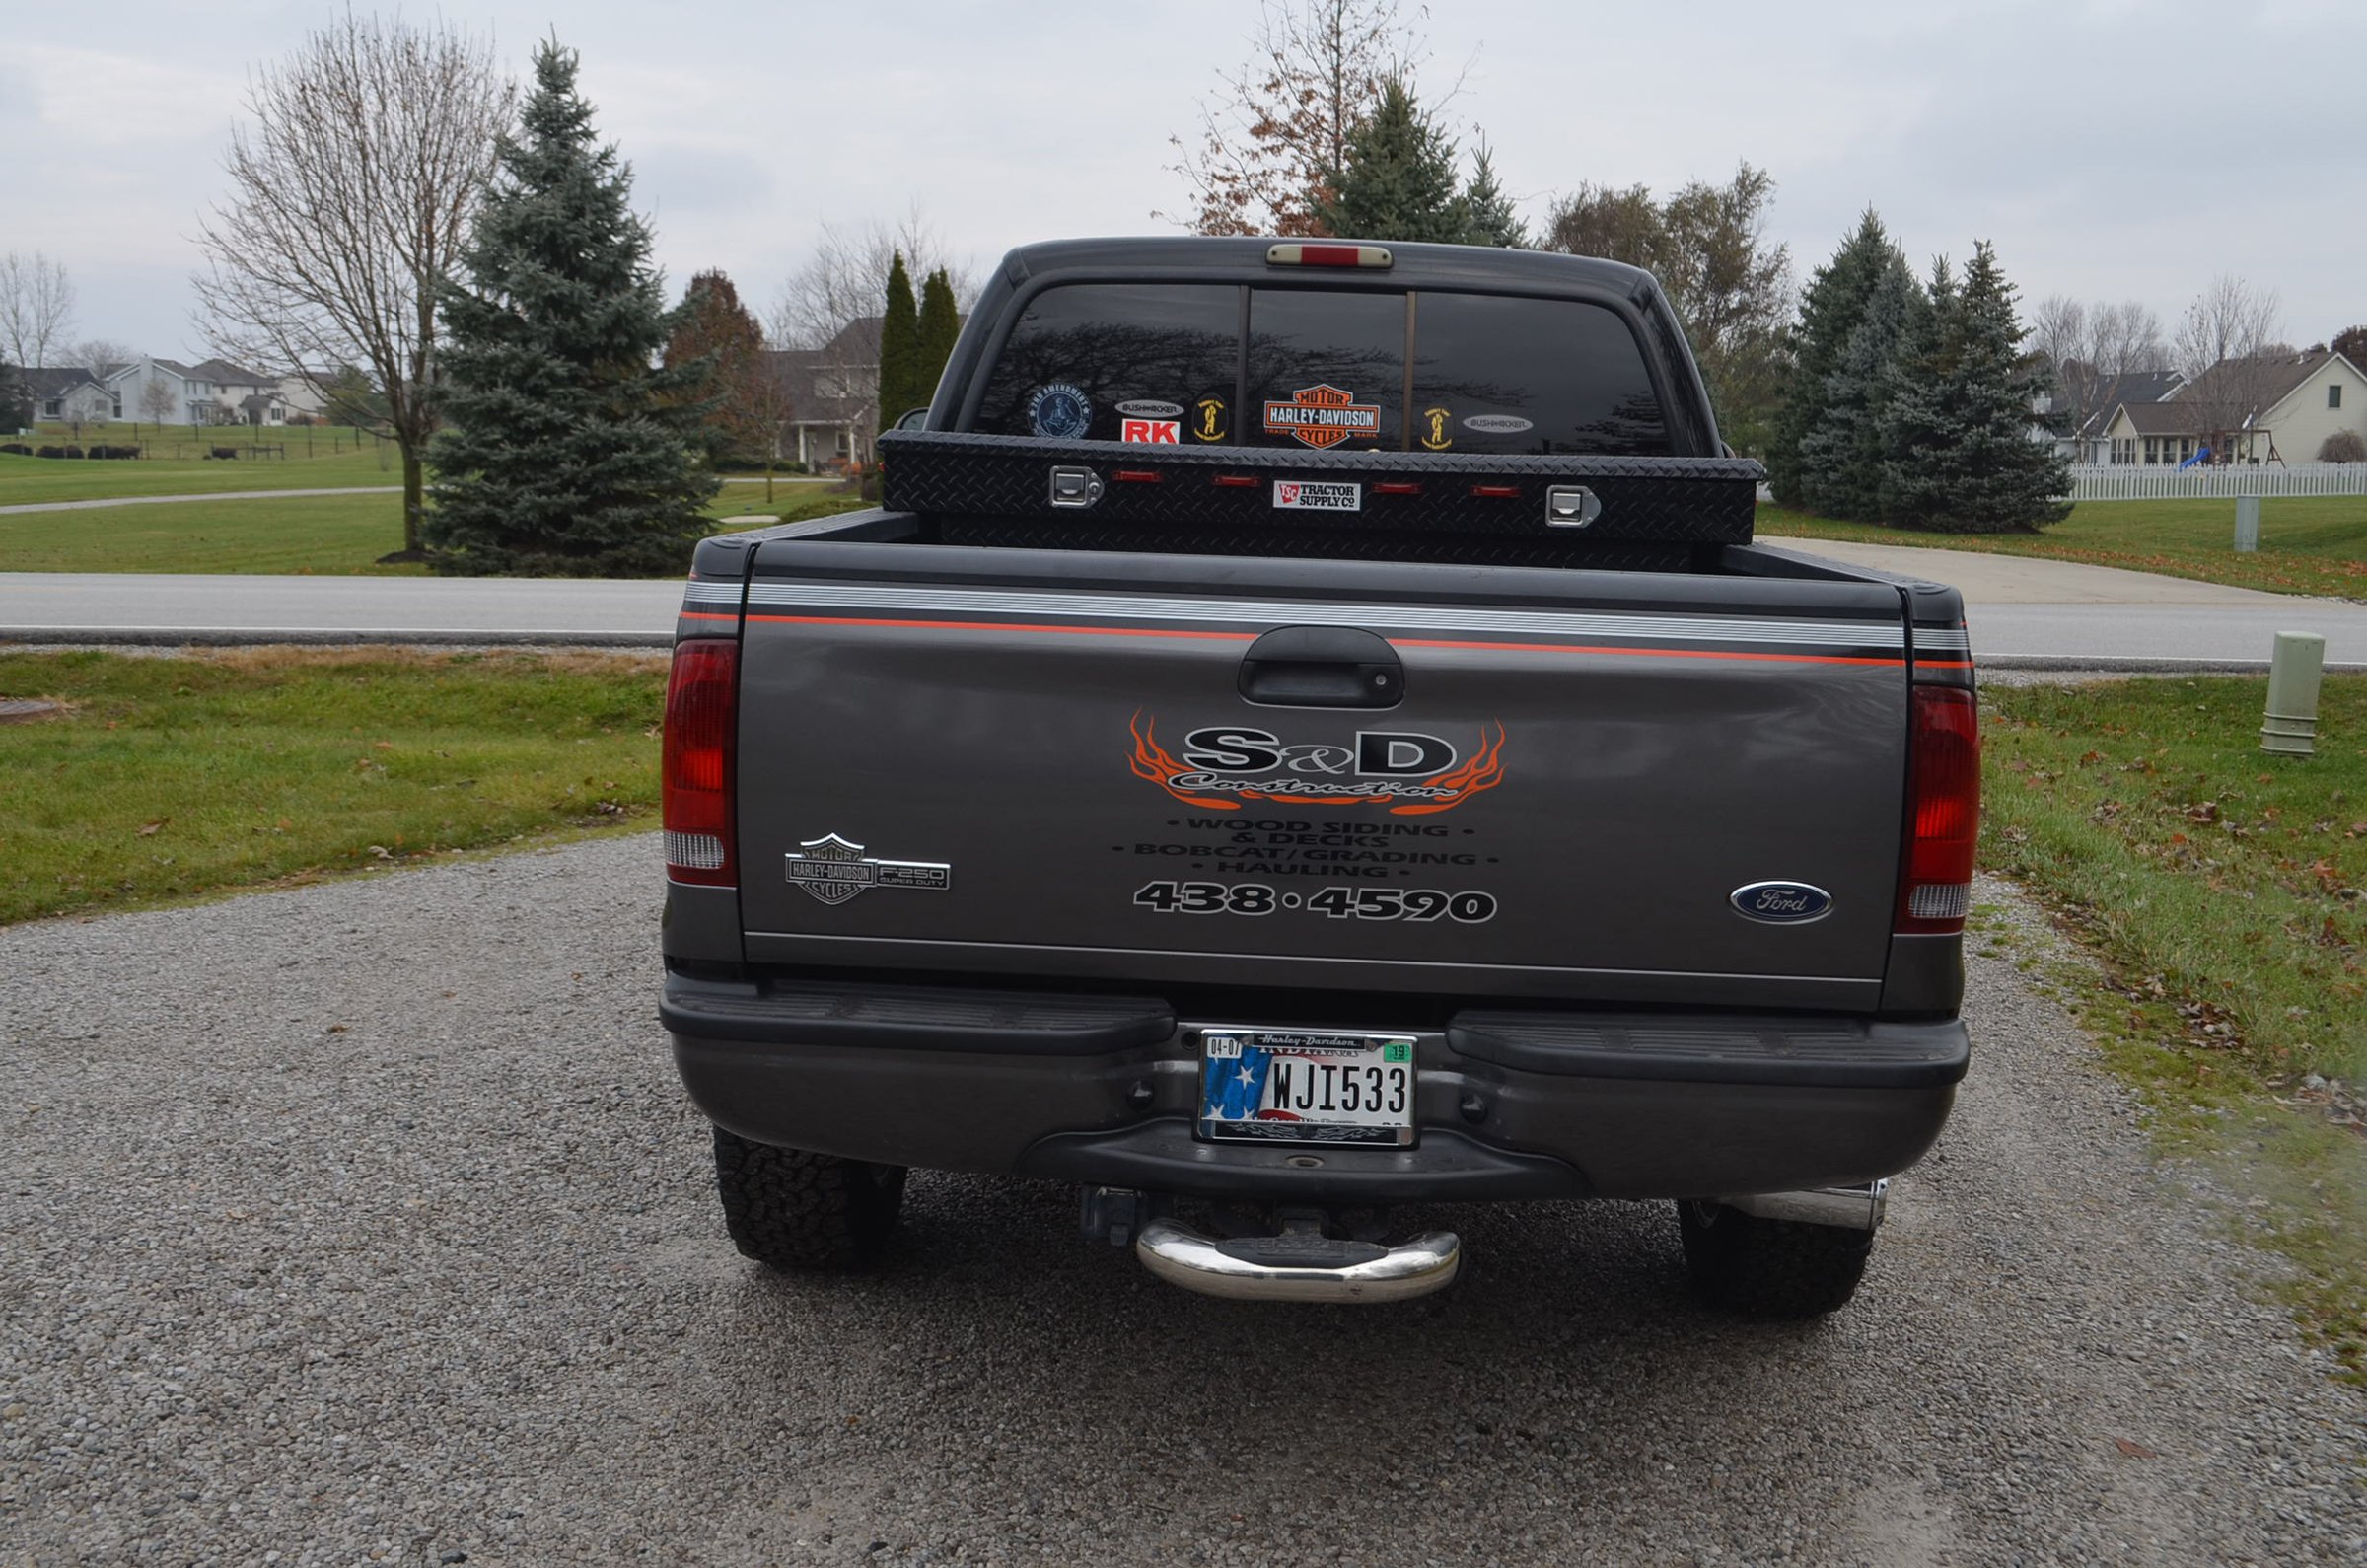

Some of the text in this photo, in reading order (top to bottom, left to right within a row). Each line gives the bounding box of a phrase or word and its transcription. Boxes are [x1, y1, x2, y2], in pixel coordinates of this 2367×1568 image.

[1300, 389, 1344, 405] MOTOR
[1270, 407, 1374, 427] HARLEY-DAVIDSON
[1125, 421, 1177, 444] RK
[1299, 429, 1345, 446] CYCLES
[1280, 484, 1297, 501] TSC
[1300, 484, 1355, 497] TRACTOR
[1300, 496, 1340, 508] SUPPLY
[1184, 726, 1458, 777] S&D
[1168, 771, 1459, 798] Construction
[1187, 818, 1448, 837] WOOD SIDING
[1232, 831, 1390, 848] & DECKS
[812, 845, 853, 861] MOTOR
[793, 863, 870, 881] HARLEY-DAVIDSON
[880, 866, 945, 880] F-250
[1217, 862, 1389, 878] HAULING
[811, 881, 852, 898] CYCLES
[1756, 889, 1808, 911] Ford
[1258, 1034, 1356, 1048] Harley-Davidson
[1392, 1045, 1405, 1057] 19
[1273, 1062, 1406, 1113] WJI533
